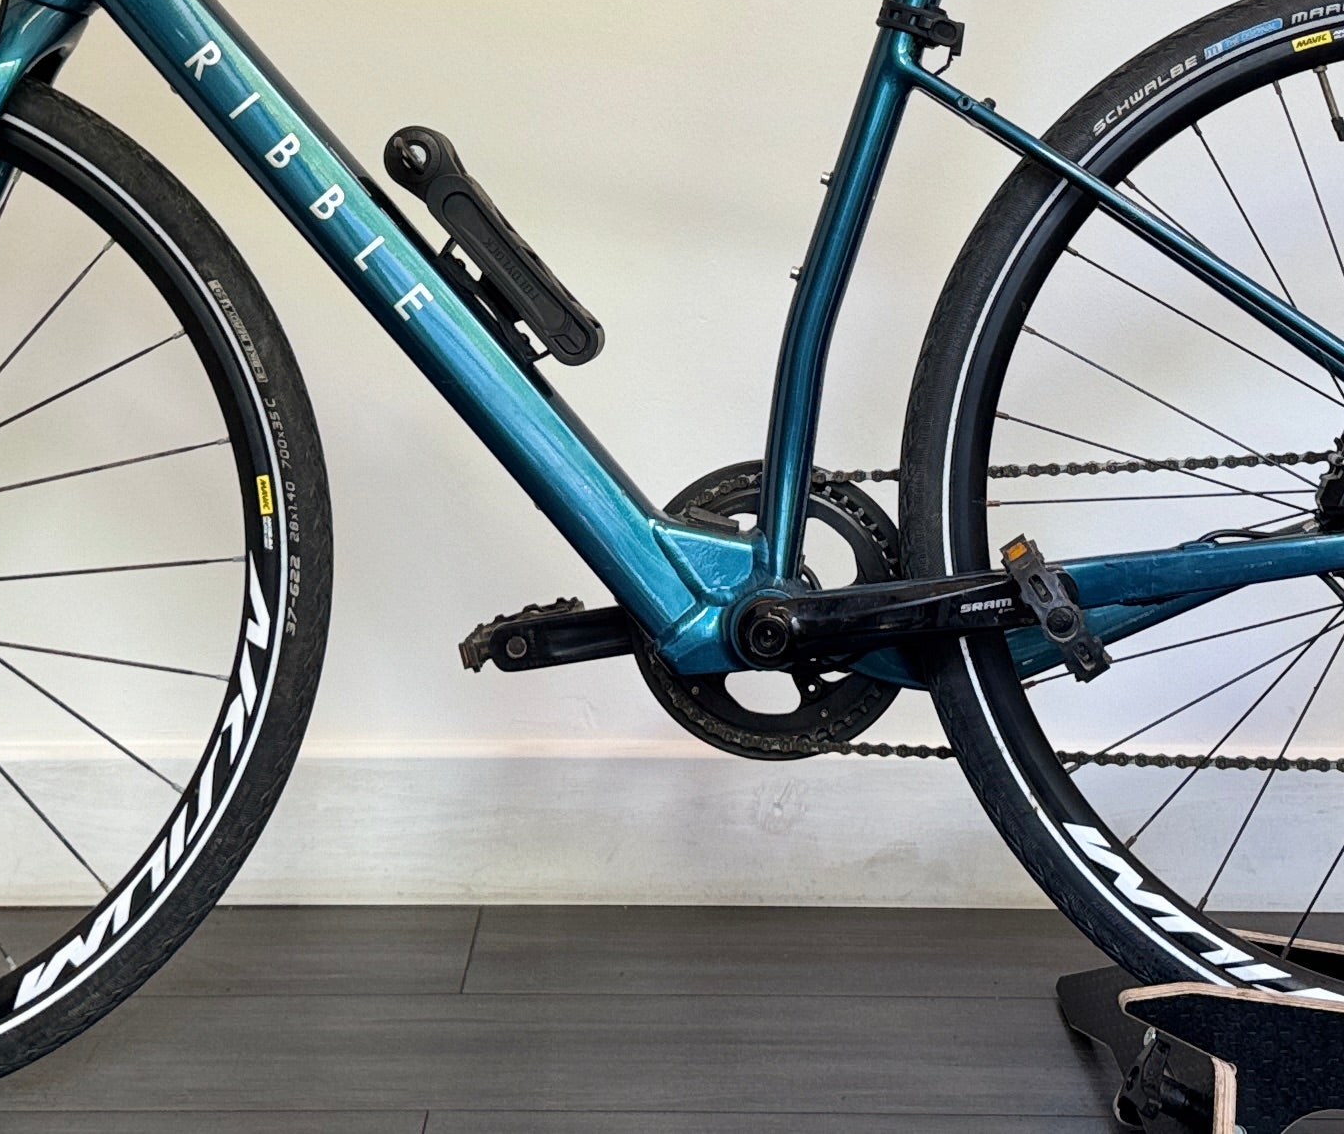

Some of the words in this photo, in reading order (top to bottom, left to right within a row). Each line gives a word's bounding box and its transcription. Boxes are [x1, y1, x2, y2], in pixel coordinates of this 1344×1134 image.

[1295, 33, 1328, 49] MAVIC
[1092, 54, 1199, 138] SCHWALBE
[184, 40, 434, 321] RIBBLE
[285, 554, 301, 637] 37-622
[959, 597, 1013, 614] SRAM
[13, 550, 271, 1009] AKSIUM
